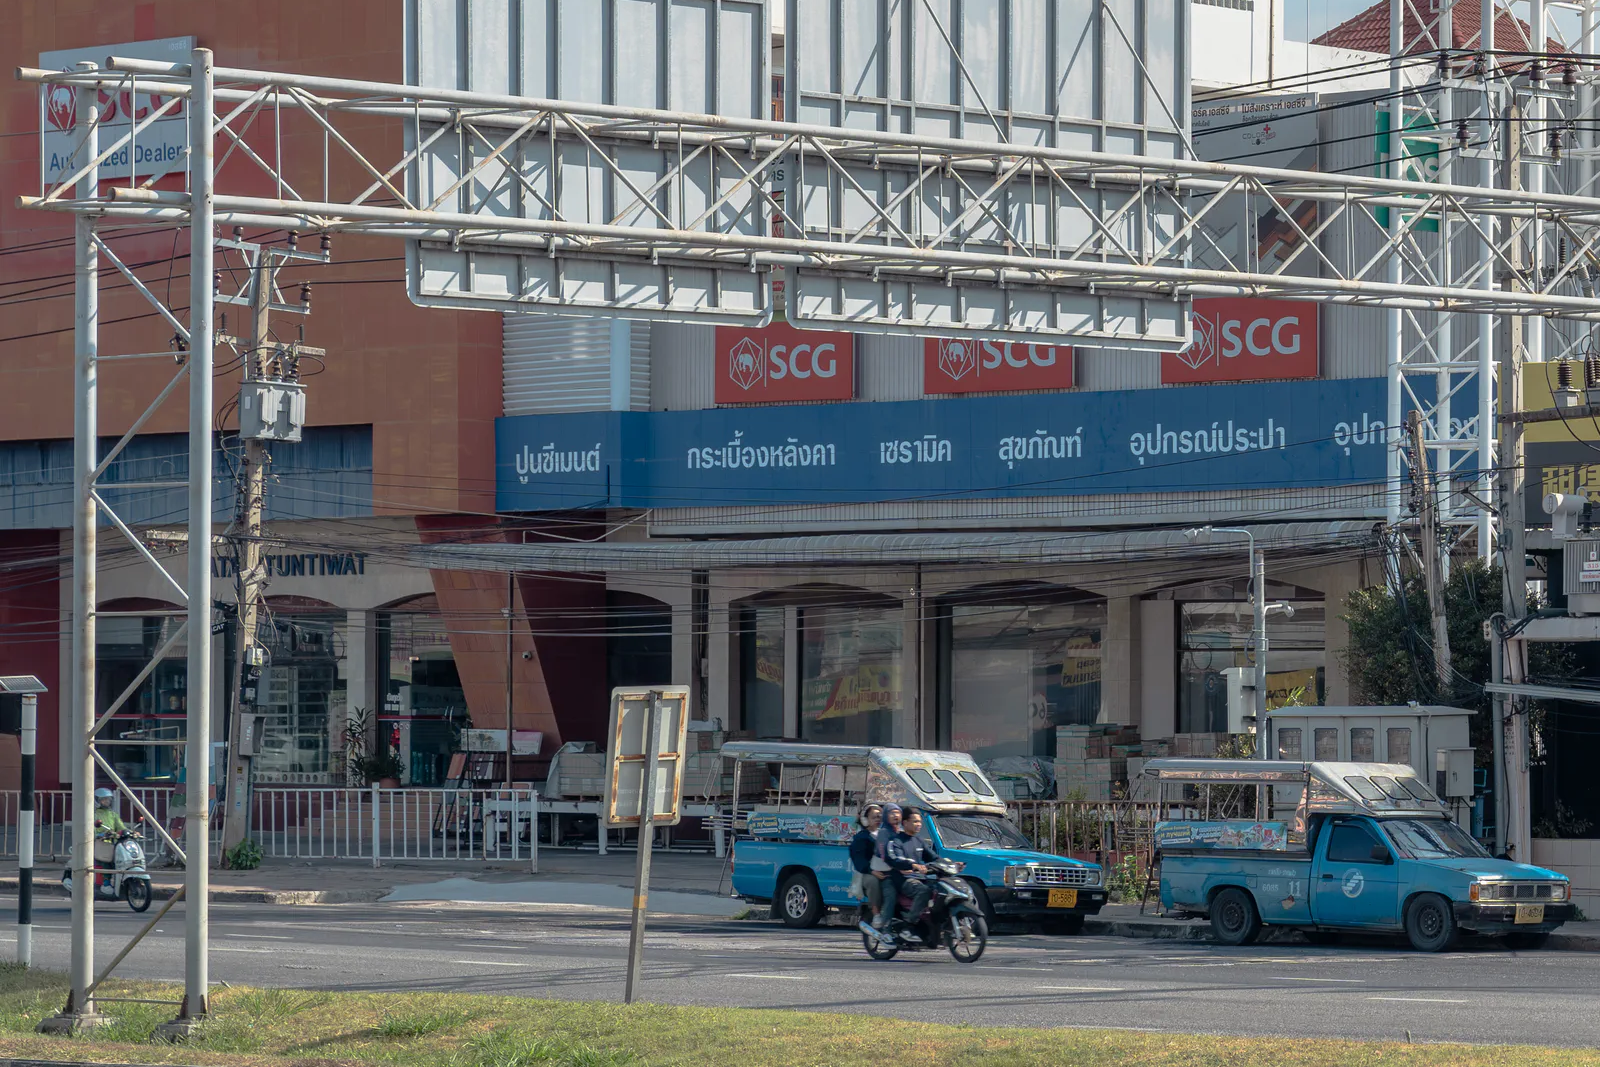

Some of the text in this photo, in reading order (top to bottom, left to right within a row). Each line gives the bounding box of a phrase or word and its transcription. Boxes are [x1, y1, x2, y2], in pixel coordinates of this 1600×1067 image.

[133, 142, 182, 164] Dealer
[983, 340, 1056, 369] SCG
[1222, 316, 1301, 358] SCG
[770, 343, 837, 379] SCG
[687, 430, 836, 468] กระเบื้องหลังคา
[880, 435, 952, 464] เซรามิค
[999, 427, 1082, 469] สุขภัณฑ์
[1130, 419, 1286, 466] อุปกรณ์ประปา
[515, 442, 601, 484] ปูนซีเมนต์
[263, 553, 368, 577] TUNTIWAT
